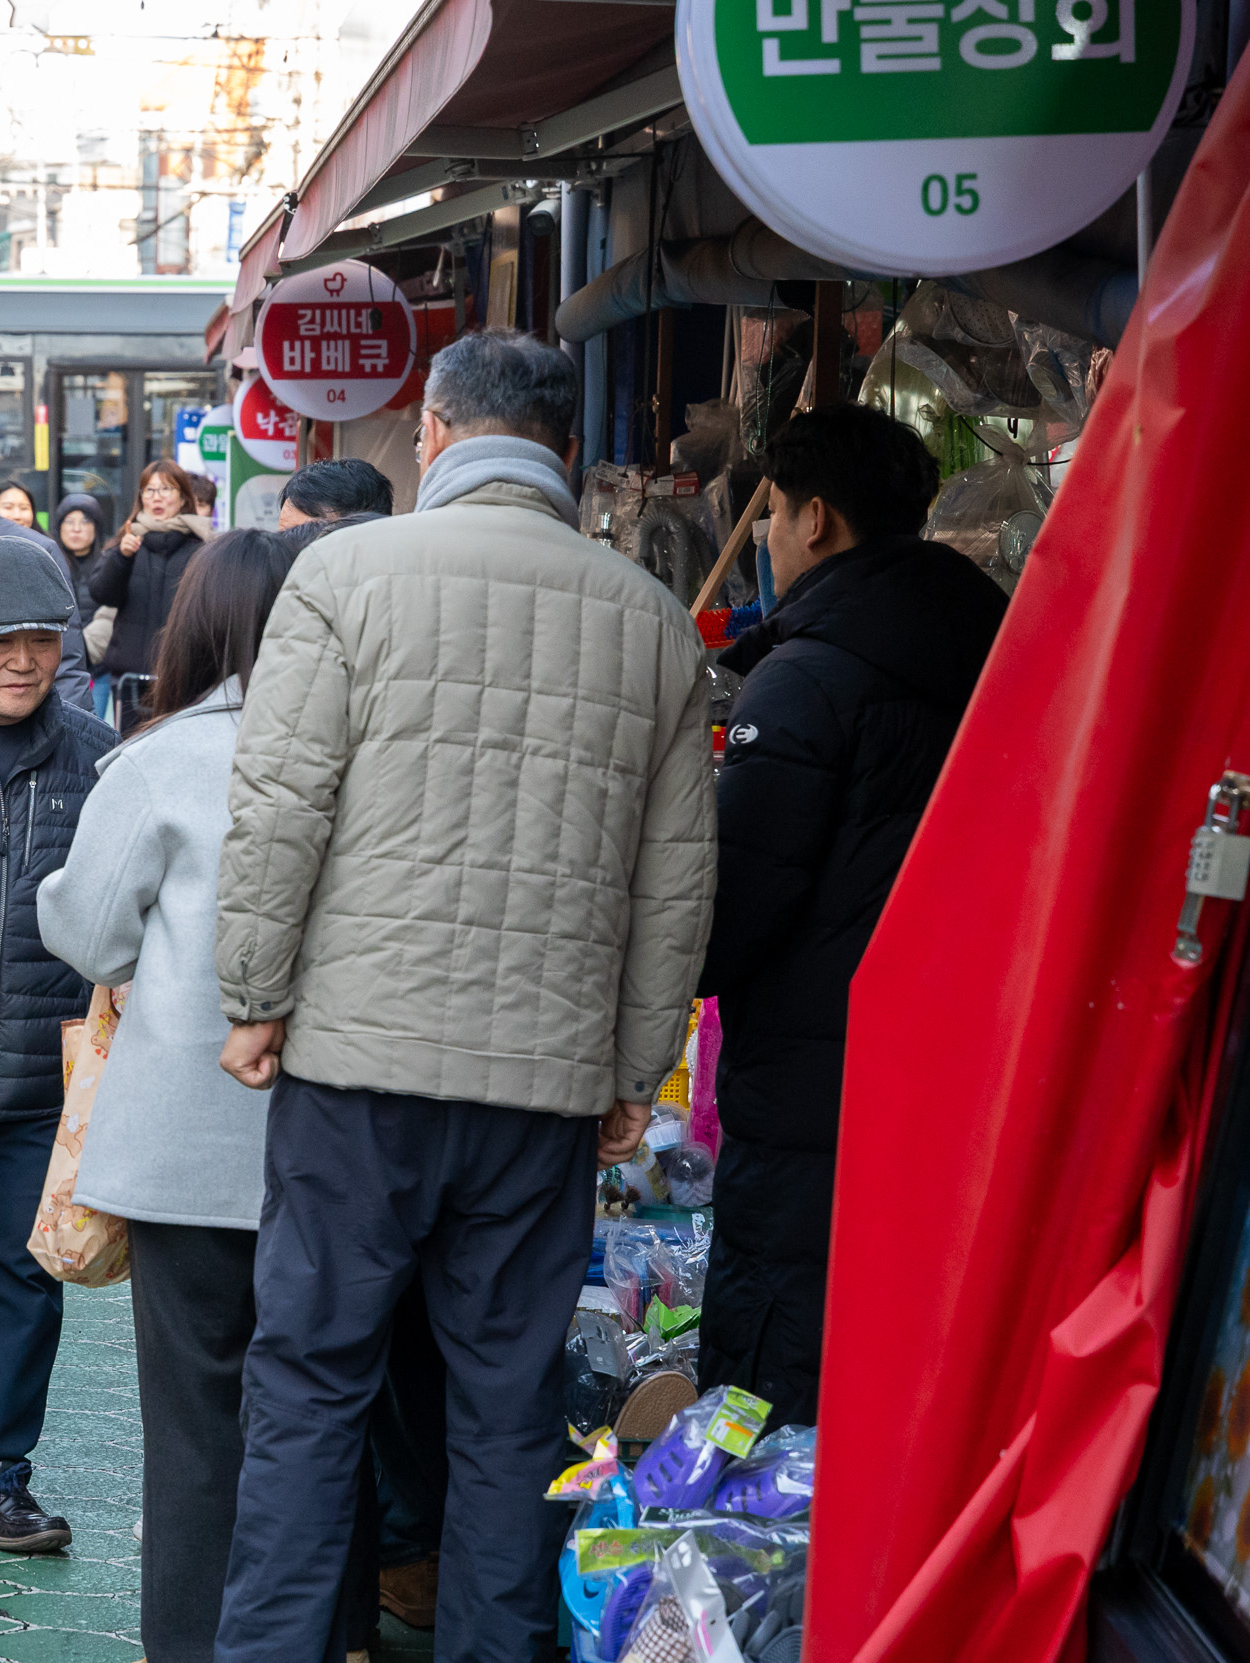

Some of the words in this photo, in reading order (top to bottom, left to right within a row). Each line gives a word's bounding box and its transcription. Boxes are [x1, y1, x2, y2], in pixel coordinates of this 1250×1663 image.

[921, 172, 981, 217] 05
[297, 308, 374, 336] 김씨네
[282, 339, 390, 373] 바베큐
[326, 388, 347, 403] 04
